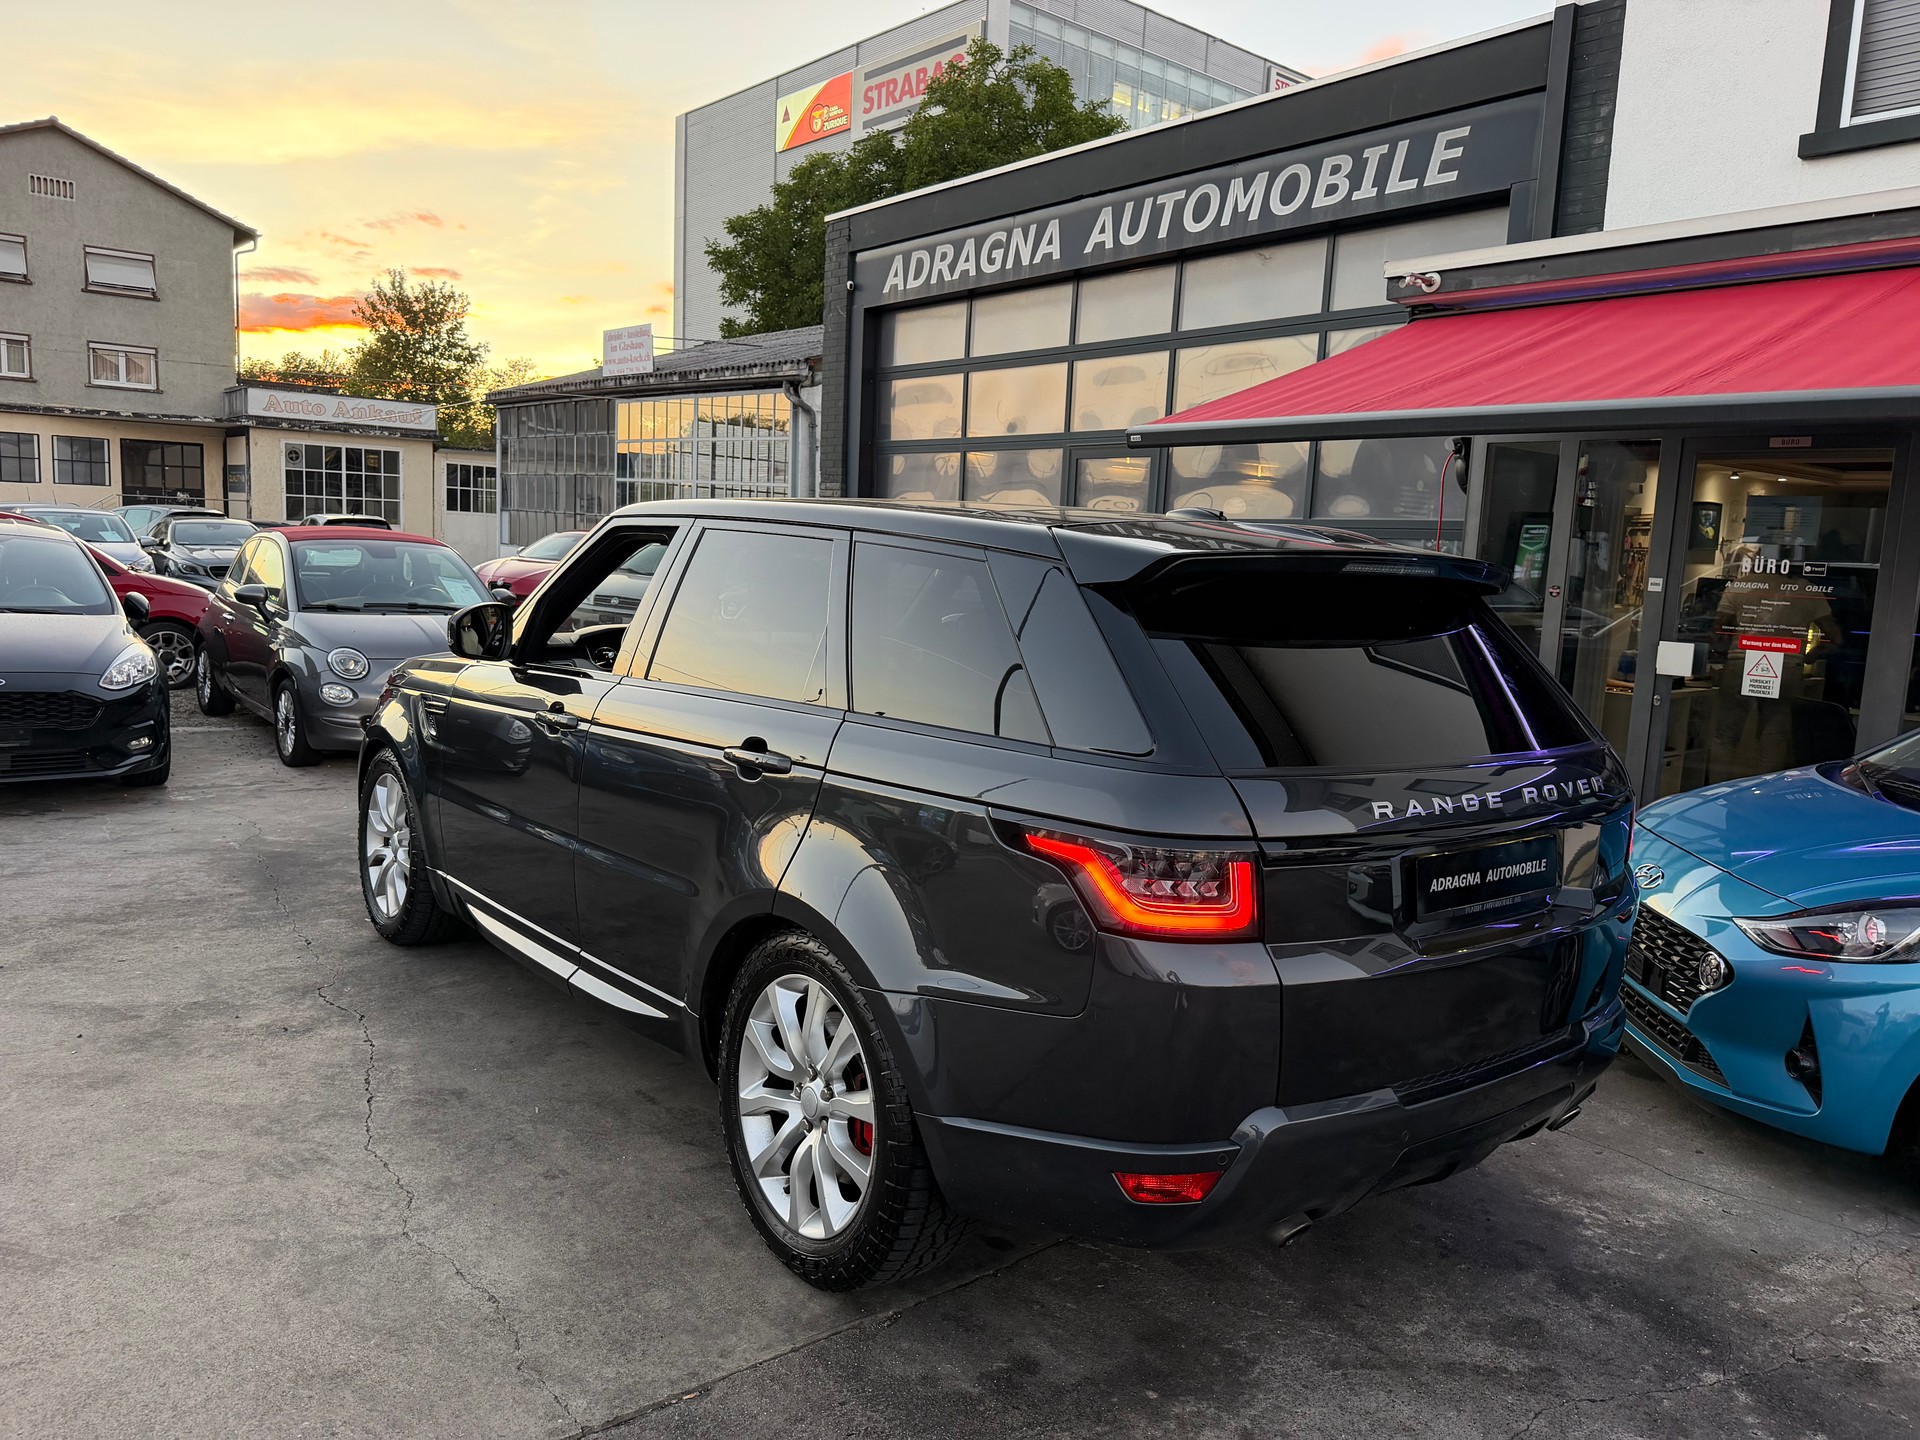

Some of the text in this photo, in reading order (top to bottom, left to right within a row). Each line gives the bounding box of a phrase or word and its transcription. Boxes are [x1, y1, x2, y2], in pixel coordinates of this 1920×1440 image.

[823, 115, 848, 131] ZURIQUE
[883, 125, 1472, 294] ADRAGNA AUTOMOBILE
[619, 340, 644, 351] Glashaus
[263, 394, 422, 425] Auto Ankauf
[1741, 556, 1790, 574] BÜRO
[1742, 640, 1762, 648] Warnung
[1370, 776, 1605, 820] RANGE ROVER
[1429, 858, 1547, 893] ADRAGNA AUTOMOBILE
